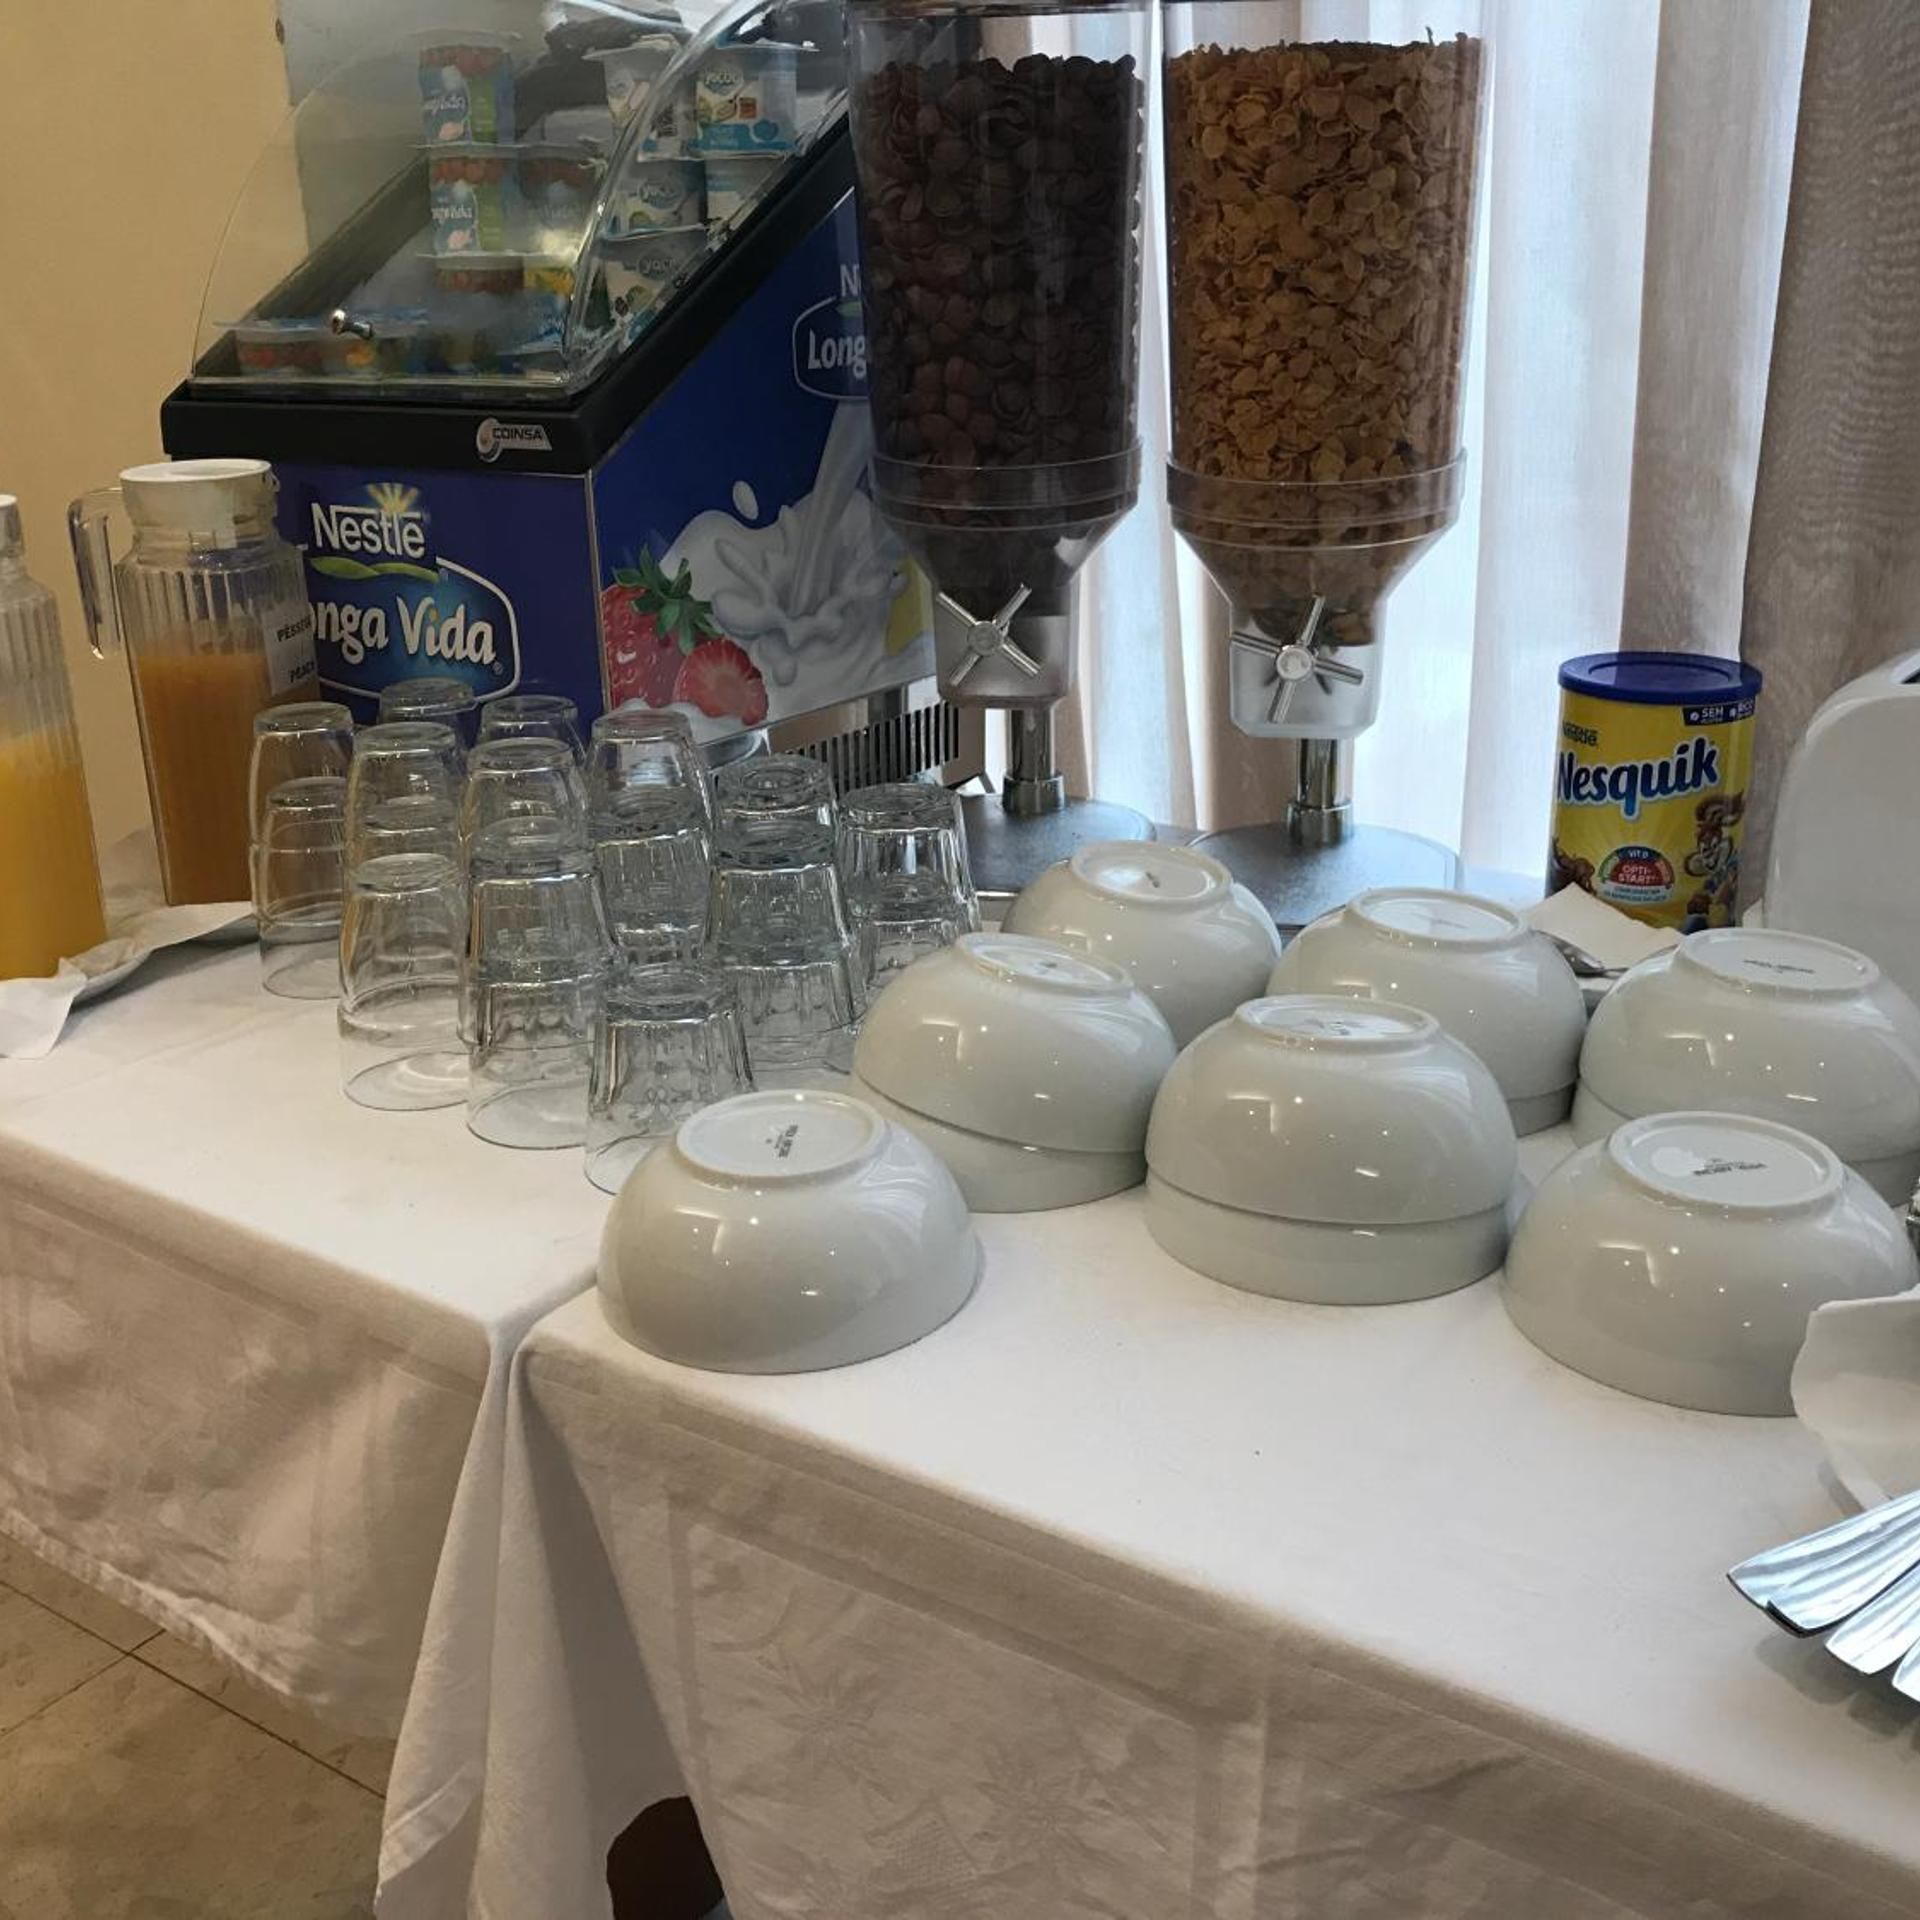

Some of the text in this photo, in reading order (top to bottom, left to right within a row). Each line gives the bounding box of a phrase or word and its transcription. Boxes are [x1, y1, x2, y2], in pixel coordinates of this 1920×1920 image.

[493, 426, 542, 440] COINSA
[396, 596, 497, 666] Vida
[1558, 737, 1718, 817] Nesquik
